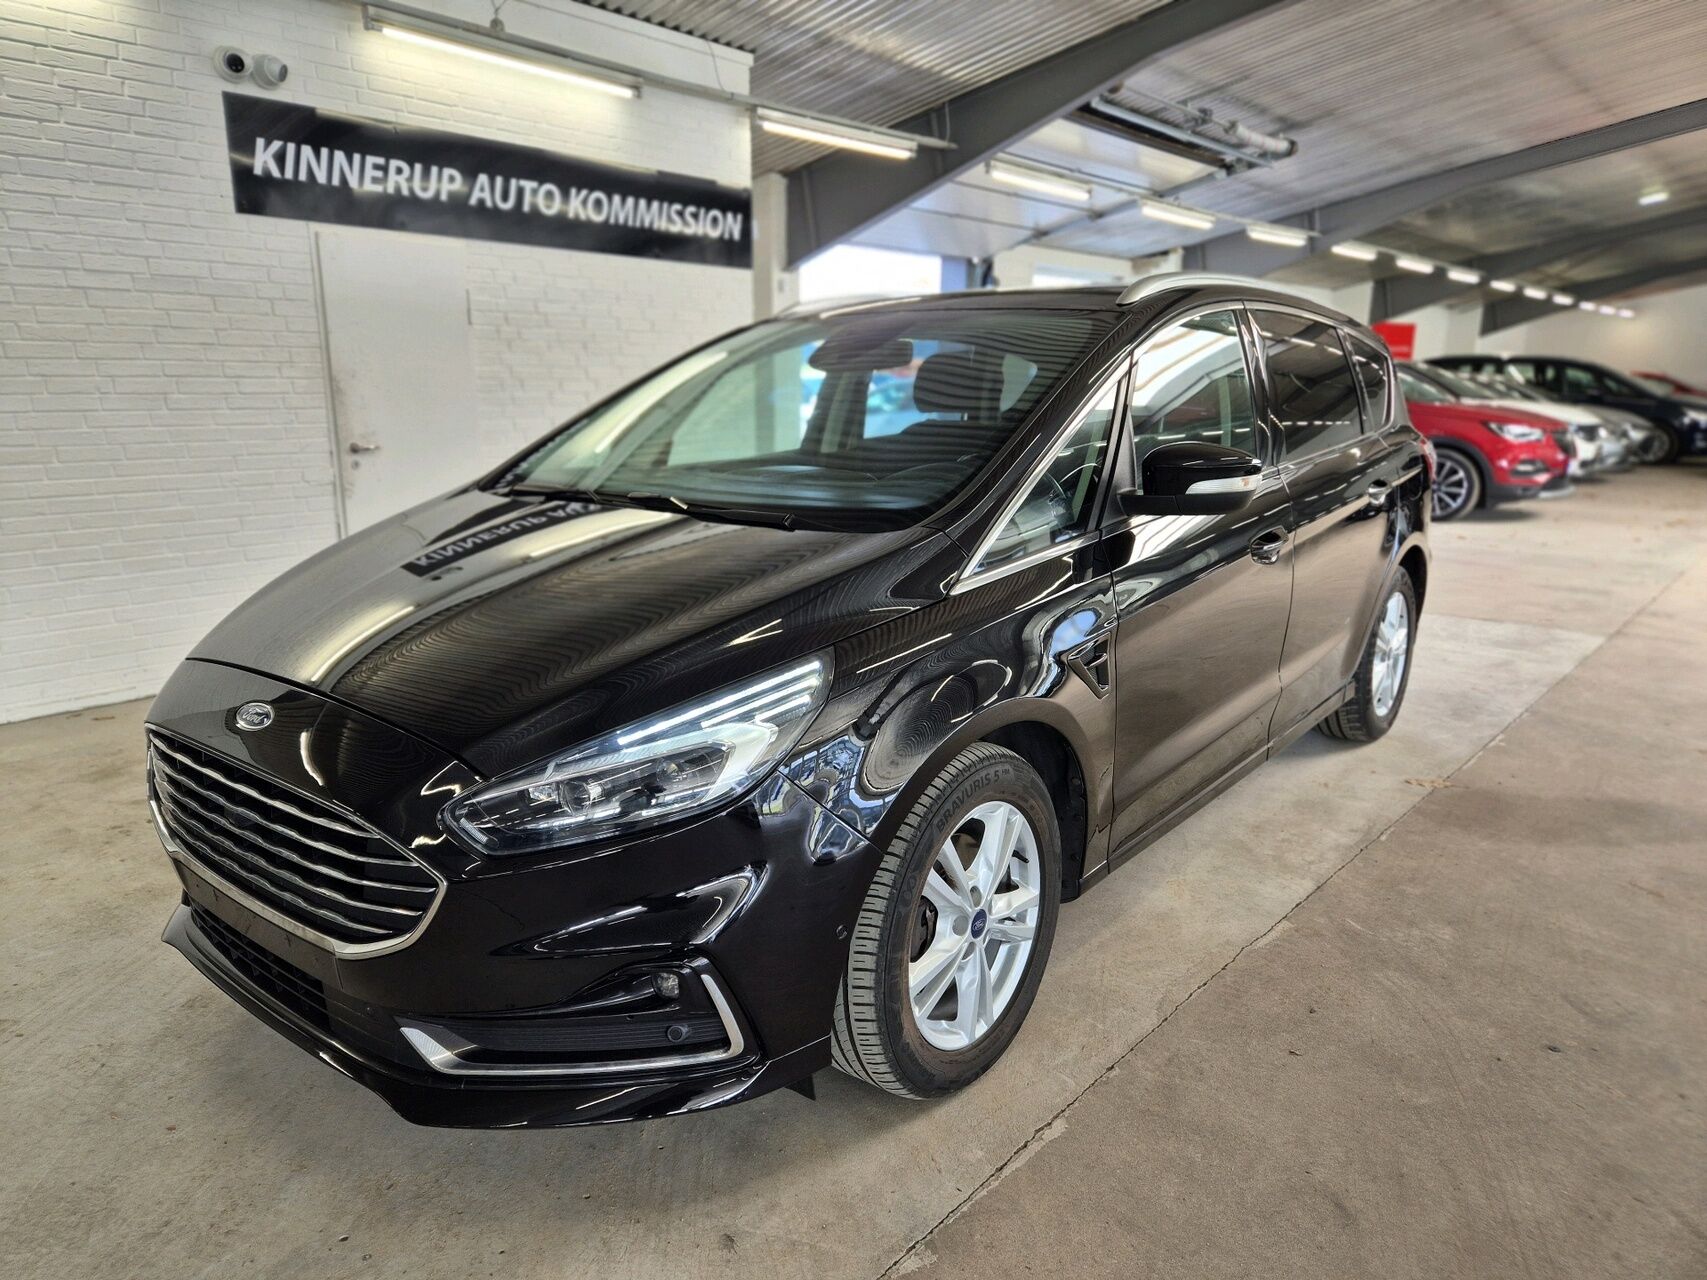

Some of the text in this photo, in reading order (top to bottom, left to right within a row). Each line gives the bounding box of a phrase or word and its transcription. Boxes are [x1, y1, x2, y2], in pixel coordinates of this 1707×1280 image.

[252, 137, 743, 241] KINNERUP AUTO KOMMISSION
[936, 772, 991, 832] BRAVURIS
